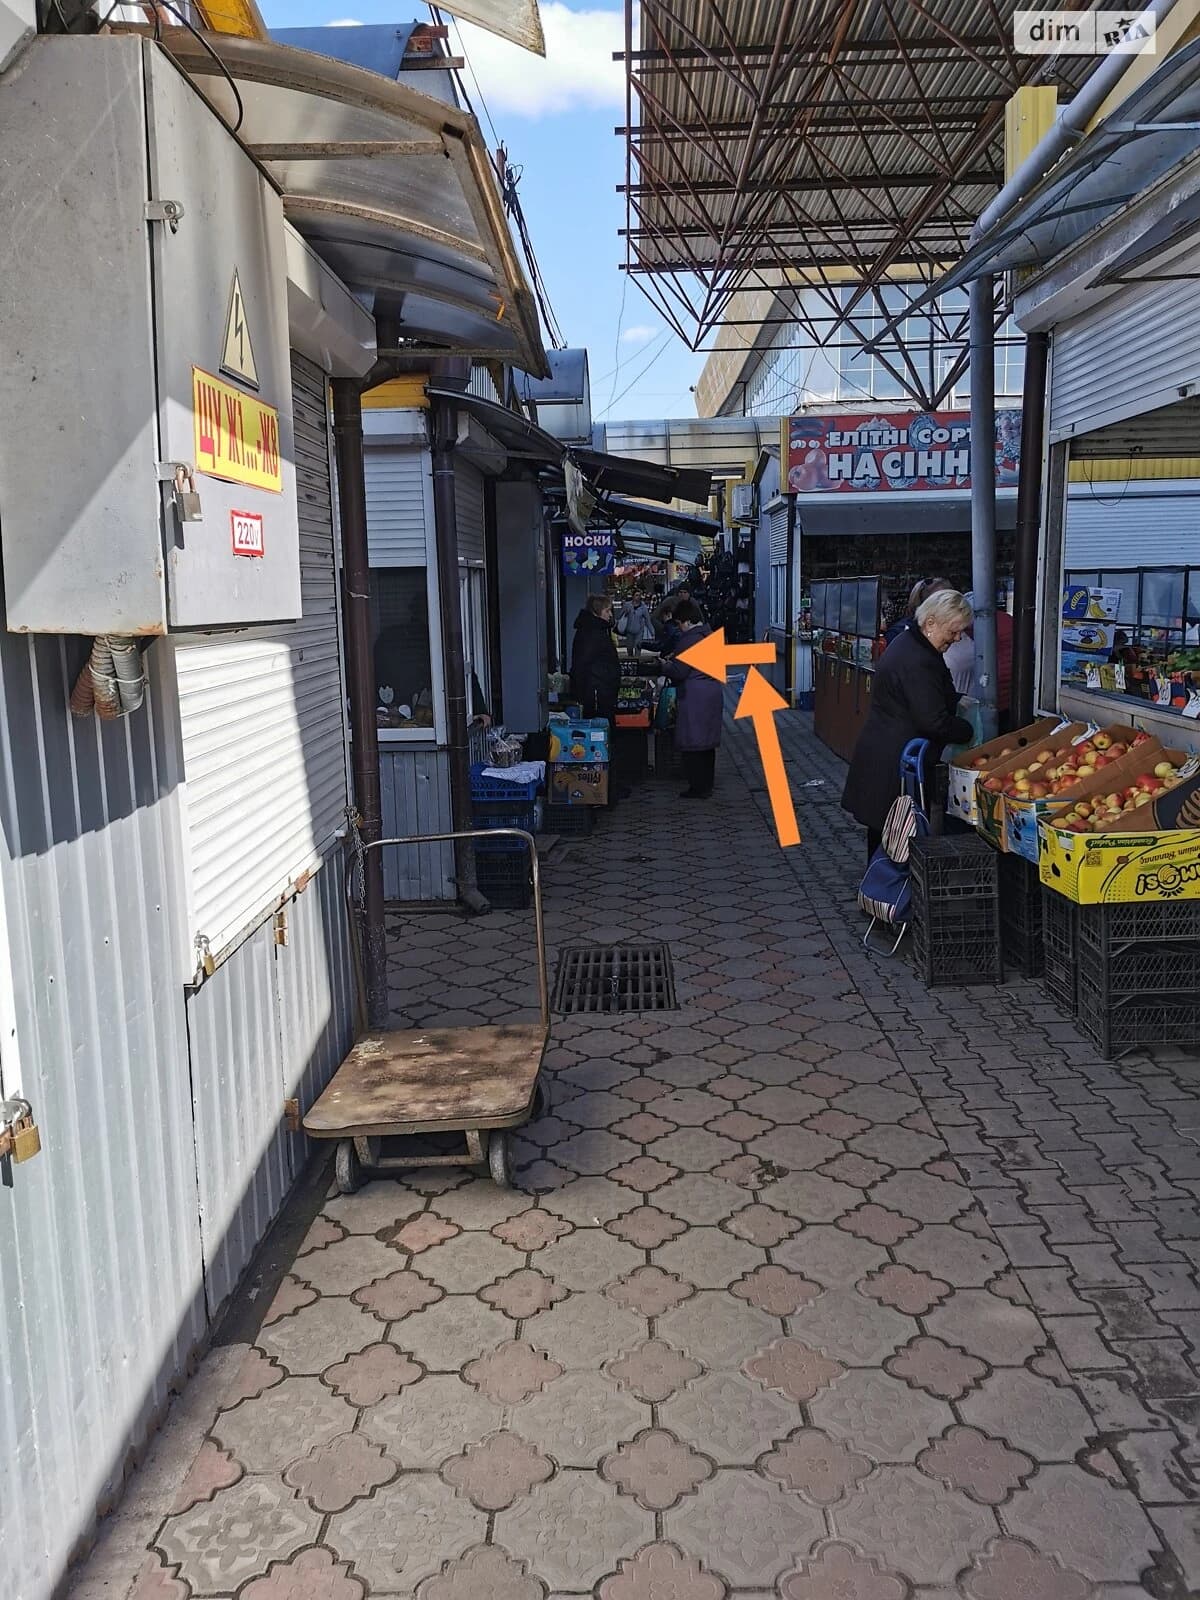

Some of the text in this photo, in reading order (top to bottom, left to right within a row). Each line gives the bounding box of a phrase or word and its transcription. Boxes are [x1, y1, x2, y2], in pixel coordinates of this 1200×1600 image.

[197, 380, 222, 469] ЩУ
[829, 429, 908, 447] ЕЛІТНІ
[828, 450, 970, 480] НАСІНН
[564, 535, 611, 547] НОСКИ
